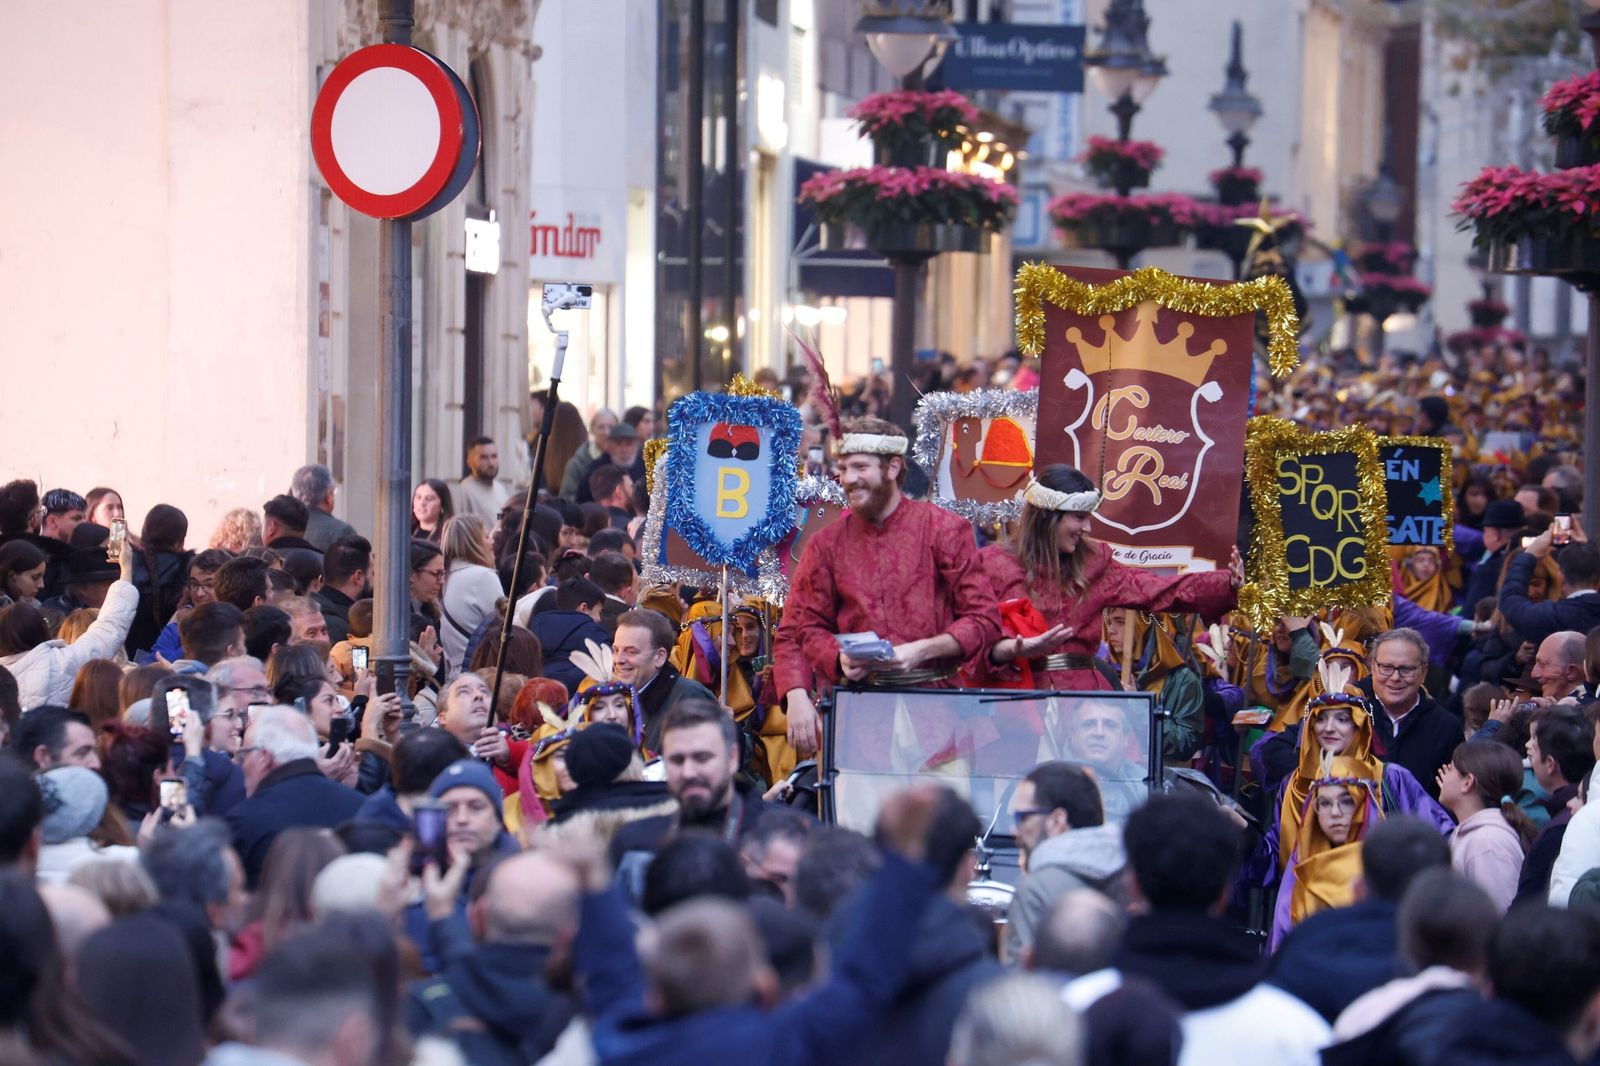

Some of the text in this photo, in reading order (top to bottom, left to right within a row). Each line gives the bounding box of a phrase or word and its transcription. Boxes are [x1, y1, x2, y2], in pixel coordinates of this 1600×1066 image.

[1092, 385, 1190, 444] Cartero
[716, 466, 750, 519] B
[1103, 446, 1188, 505] Real
[1275, 456, 1362, 533] SPQR
[1124, 550, 1137, 560] de
[1139, 549, 1173, 564] Gracia
[1284, 535, 1367, 588] CDG
